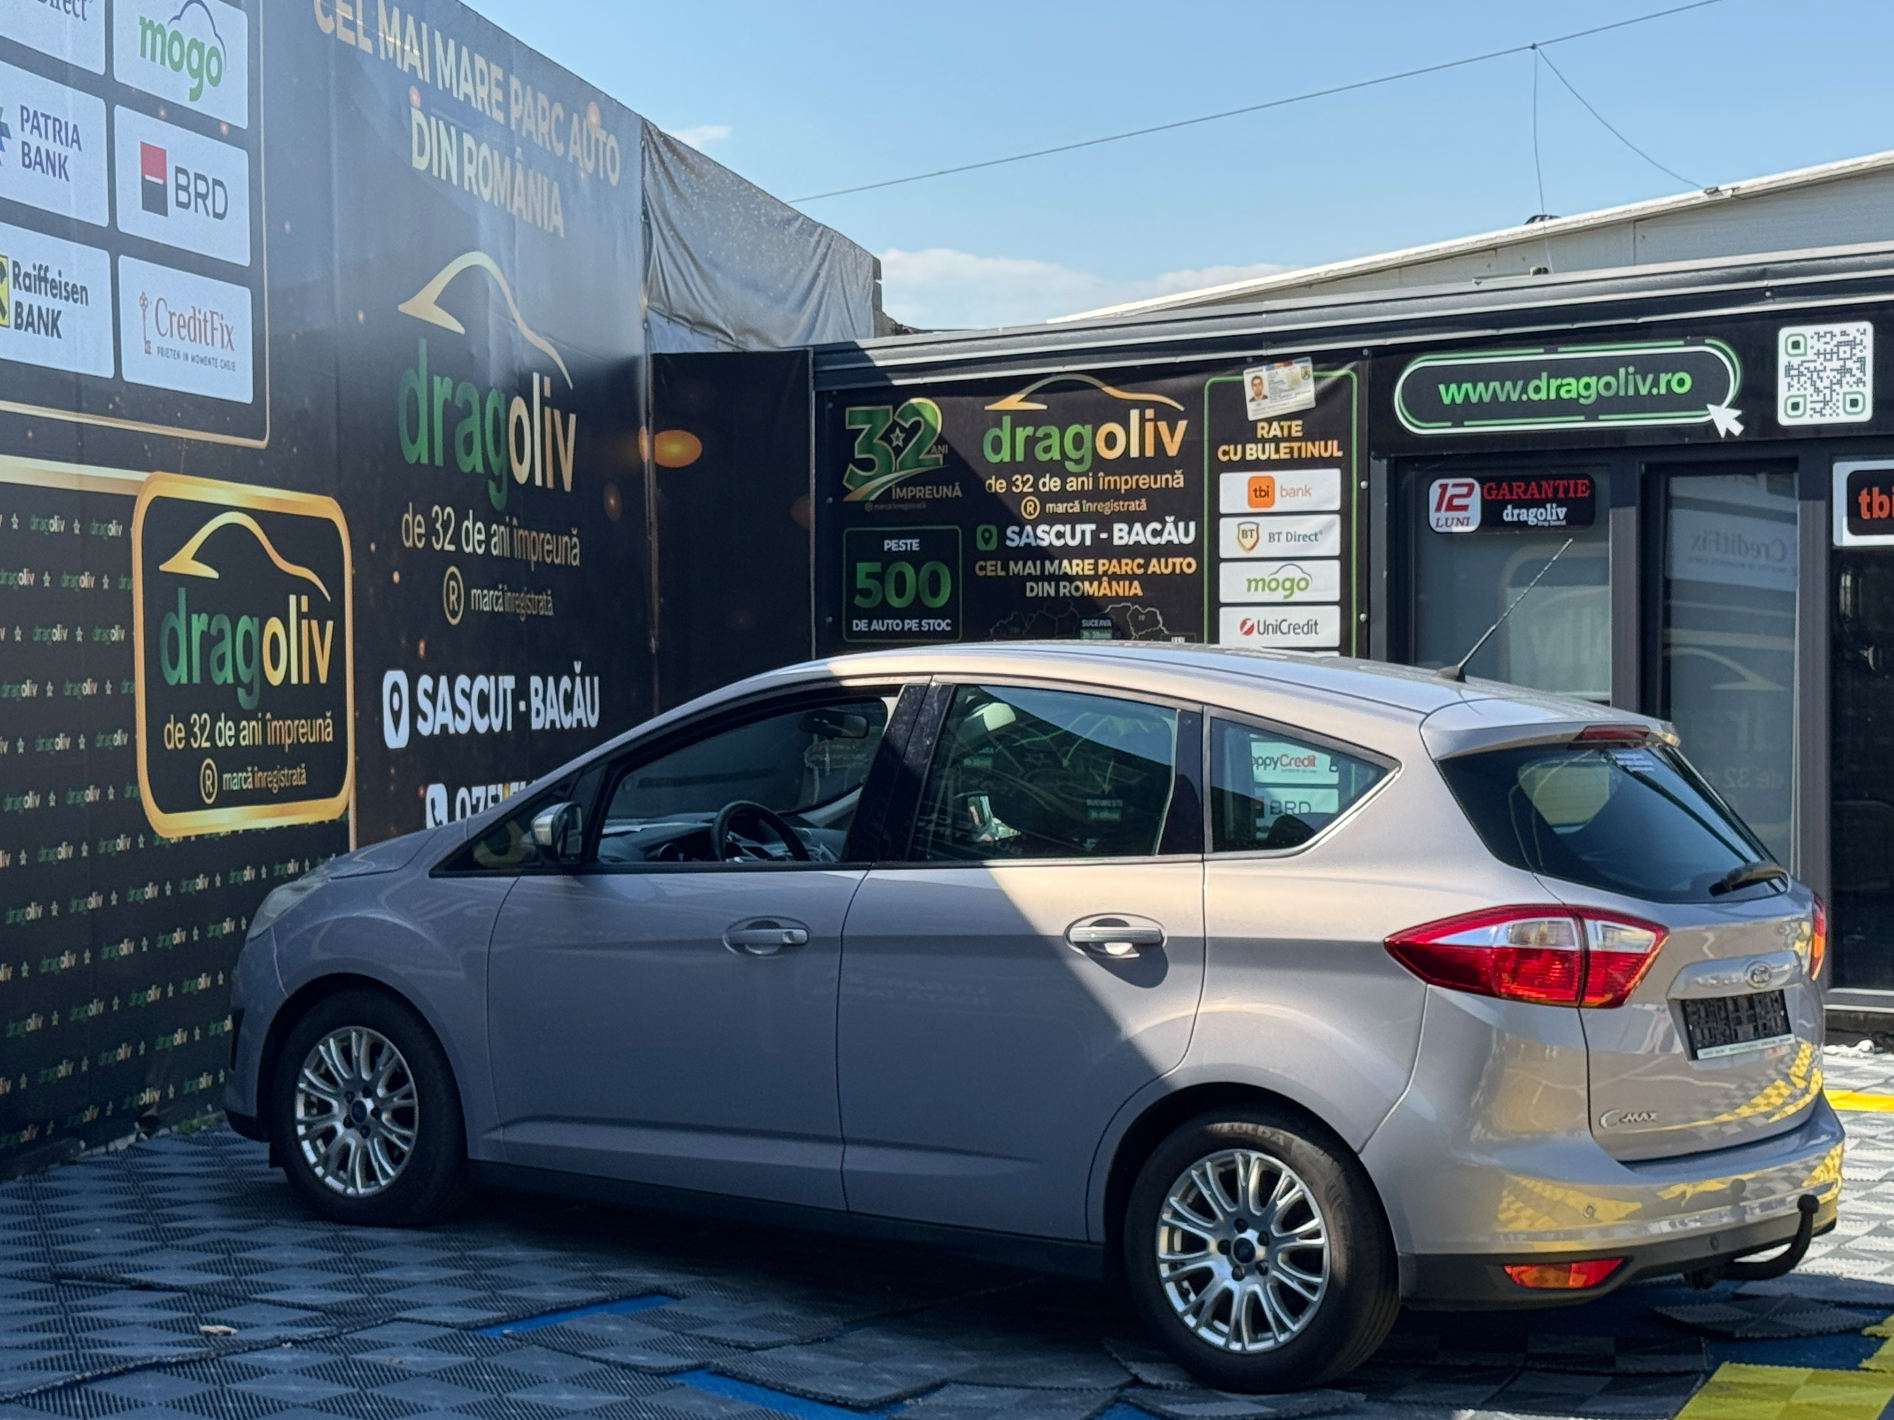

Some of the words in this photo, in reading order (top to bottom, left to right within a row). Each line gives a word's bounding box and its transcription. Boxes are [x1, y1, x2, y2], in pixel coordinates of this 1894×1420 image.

[139, 16, 223, 102] mogo
[313, 0, 373, 54] CEL
[378, 0, 431, 84] MAI
[434, 29, 505, 125] MARE
[509, 74, 565, 157] PARC
[568, 111, 621, 186] AUTO
[19, 104, 82, 152] PATRIA
[21, 140, 70, 182] BANK
[410, 107, 458, 186] DIN
[462, 132, 565, 238] ROMÂNIA
[174, 165, 228, 221] BRD
[12, 260, 89, 306] Raiffeisen
[14, 301, 62, 339] BANK
[154, 297, 235, 352] CreditFix
[1438, 366, 1692, 405] www.dragoliv.ro
[399, 337, 577, 511] dragoliv
[1256, 420, 1303, 438] RATE
[842, 397, 943, 490] 32
[982, 408, 1188, 473] dragoliv
[1217, 444, 1242, 462] CU
[1245, 439, 1343, 461] BULETINUL
[985, 475, 1007, 493] de
[1011, 474, 1034, 493] 32
[1038, 472, 1062, 492] de
[1066, 472, 1093, 491] ani
[1099, 469, 1185, 494] împreună
[1252, 485, 1270, 499] tbi
[1280, 484, 1312, 498] bank
[1483, 479, 1591, 499] GARANTIE
[1045, 499, 1080, 514] marcă
[1082, 498, 1148, 516] înregistrată
[1434, 483, 1475, 513] 12
[1435, 517, 1471, 529] LUNI
[1503, 503, 1567, 527] dragoliv
[402, 502, 426, 549] de
[432, 504, 456, 551] 32
[462, 509, 486, 554] de
[491, 517, 510, 558] ani
[512, 516, 580, 571] împreună
[884, 539, 920, 551] PESTE
[1005, 523, 1097, 547] SASCUT
[1112, 515, 1196, 546] BACĂU
[1241, 529, 1255, 540] BT
[1268, 532, 1283, 543] BT
[975, 560, 1006, 577] CEL
[1008, 560, 1041, 576] MAI
[1044, 559, 1095, 575] MARE
[1099, 558, 1145, 574] PARC
[1147, 556, 1197, 574] AUTO
[471, 585, 504, 612] marcă
[853, 561, 952, 609] 500
[1026, 581, 1056, 597] DIN
[1059, 576, 1143, 597] ROMÂNIA
[1246, 575, 1310, 600] mogo
[852, 620, 869, 632] DE
[870, 619, 903, 632] AUTO
[904, 619, 920, 632] PE
[921, 619, 952, 631] STOC
[1257, 619, 1319, 636] UniCredit
[160, 587, 334, 710] dragoliv
[416, 674, 515, 736] SASCUT
[530, 660, 600, 730] BACĂU
[164, 714, 186, 750] de
[190, 712, 211, 748] 32
[215, 711, 235, 748] de
[239, 712, 262, 746] ani
[267, 711, 334, 752] împreună
[222, 766, 253, 790] marcă
[254, 763, 307, 794] înregistrată
[1270, 800, 1312, 815] BRD
